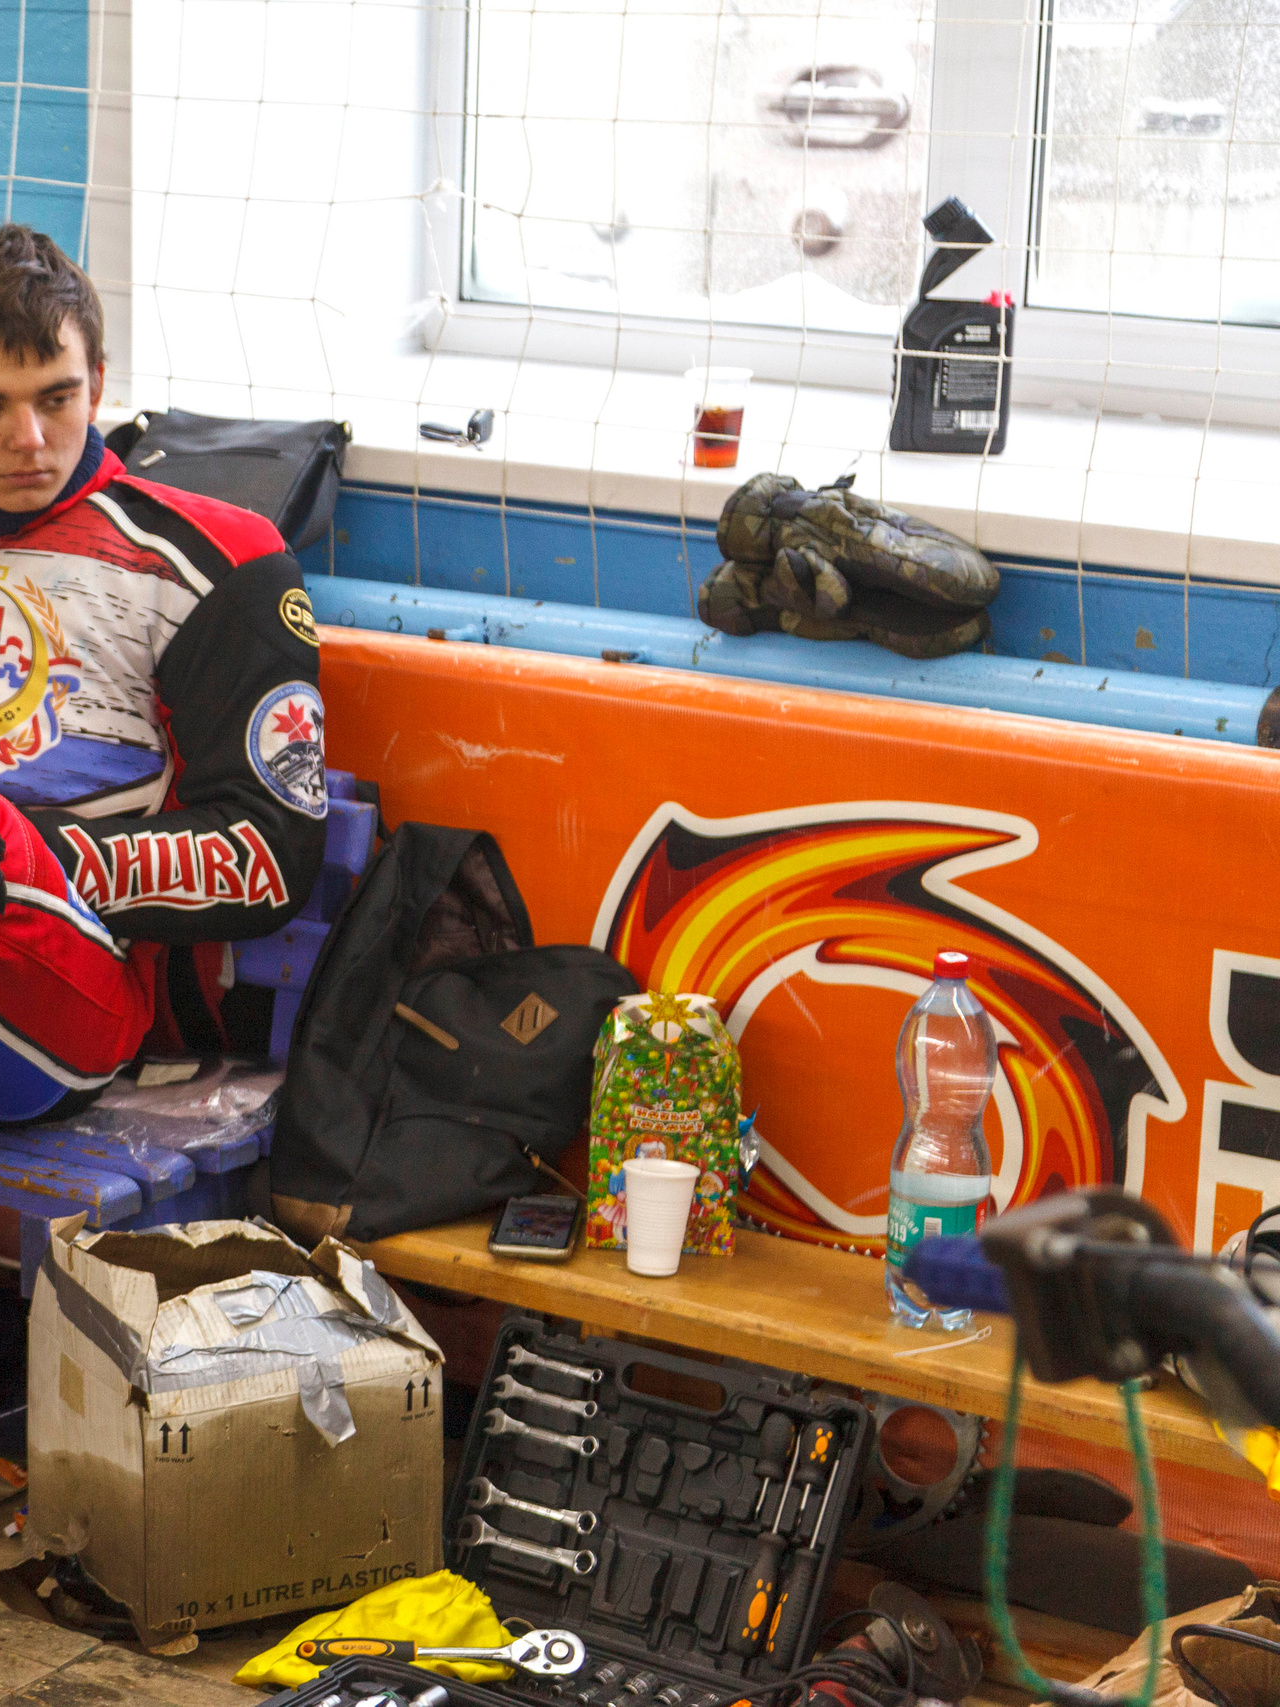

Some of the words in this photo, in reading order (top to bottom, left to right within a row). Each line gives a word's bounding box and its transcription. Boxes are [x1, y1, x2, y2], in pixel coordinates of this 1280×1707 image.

[58, 819, 290, 915] АНИВА
[176, 1601, 199, 1618] 10
[225, 1594, 234, 1609] 1
[243, 1582, 305, 1608] LITRE
[311, 1561, 418, 1595] PLASTICS
